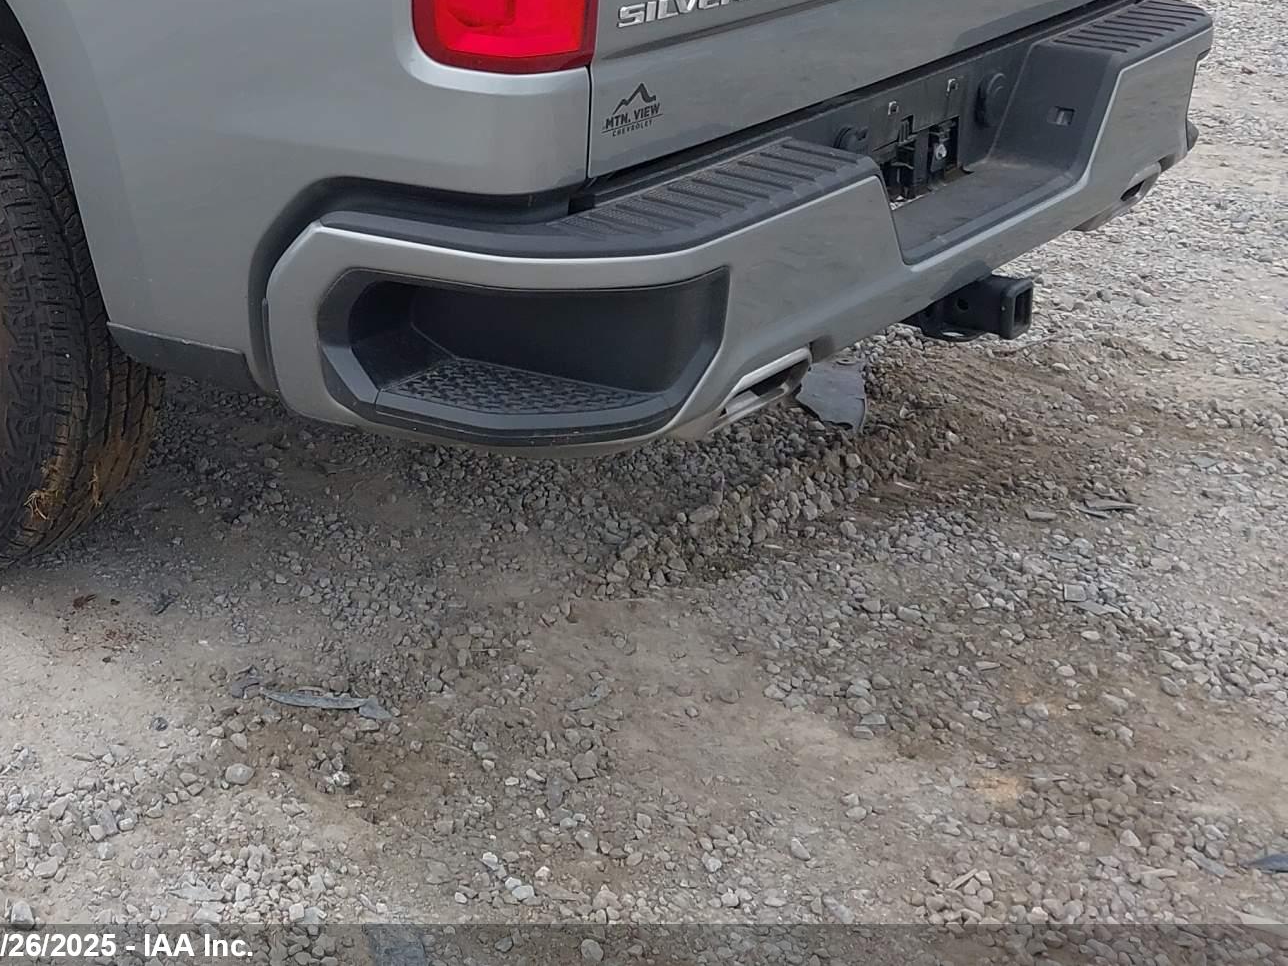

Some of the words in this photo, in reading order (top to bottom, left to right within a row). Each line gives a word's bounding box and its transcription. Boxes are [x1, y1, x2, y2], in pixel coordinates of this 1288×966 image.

[605, 113, 631, 130] MTN.
[633, 102, 661, 120] VIEW
[612, 119, 653, 137] CHEVROLET
